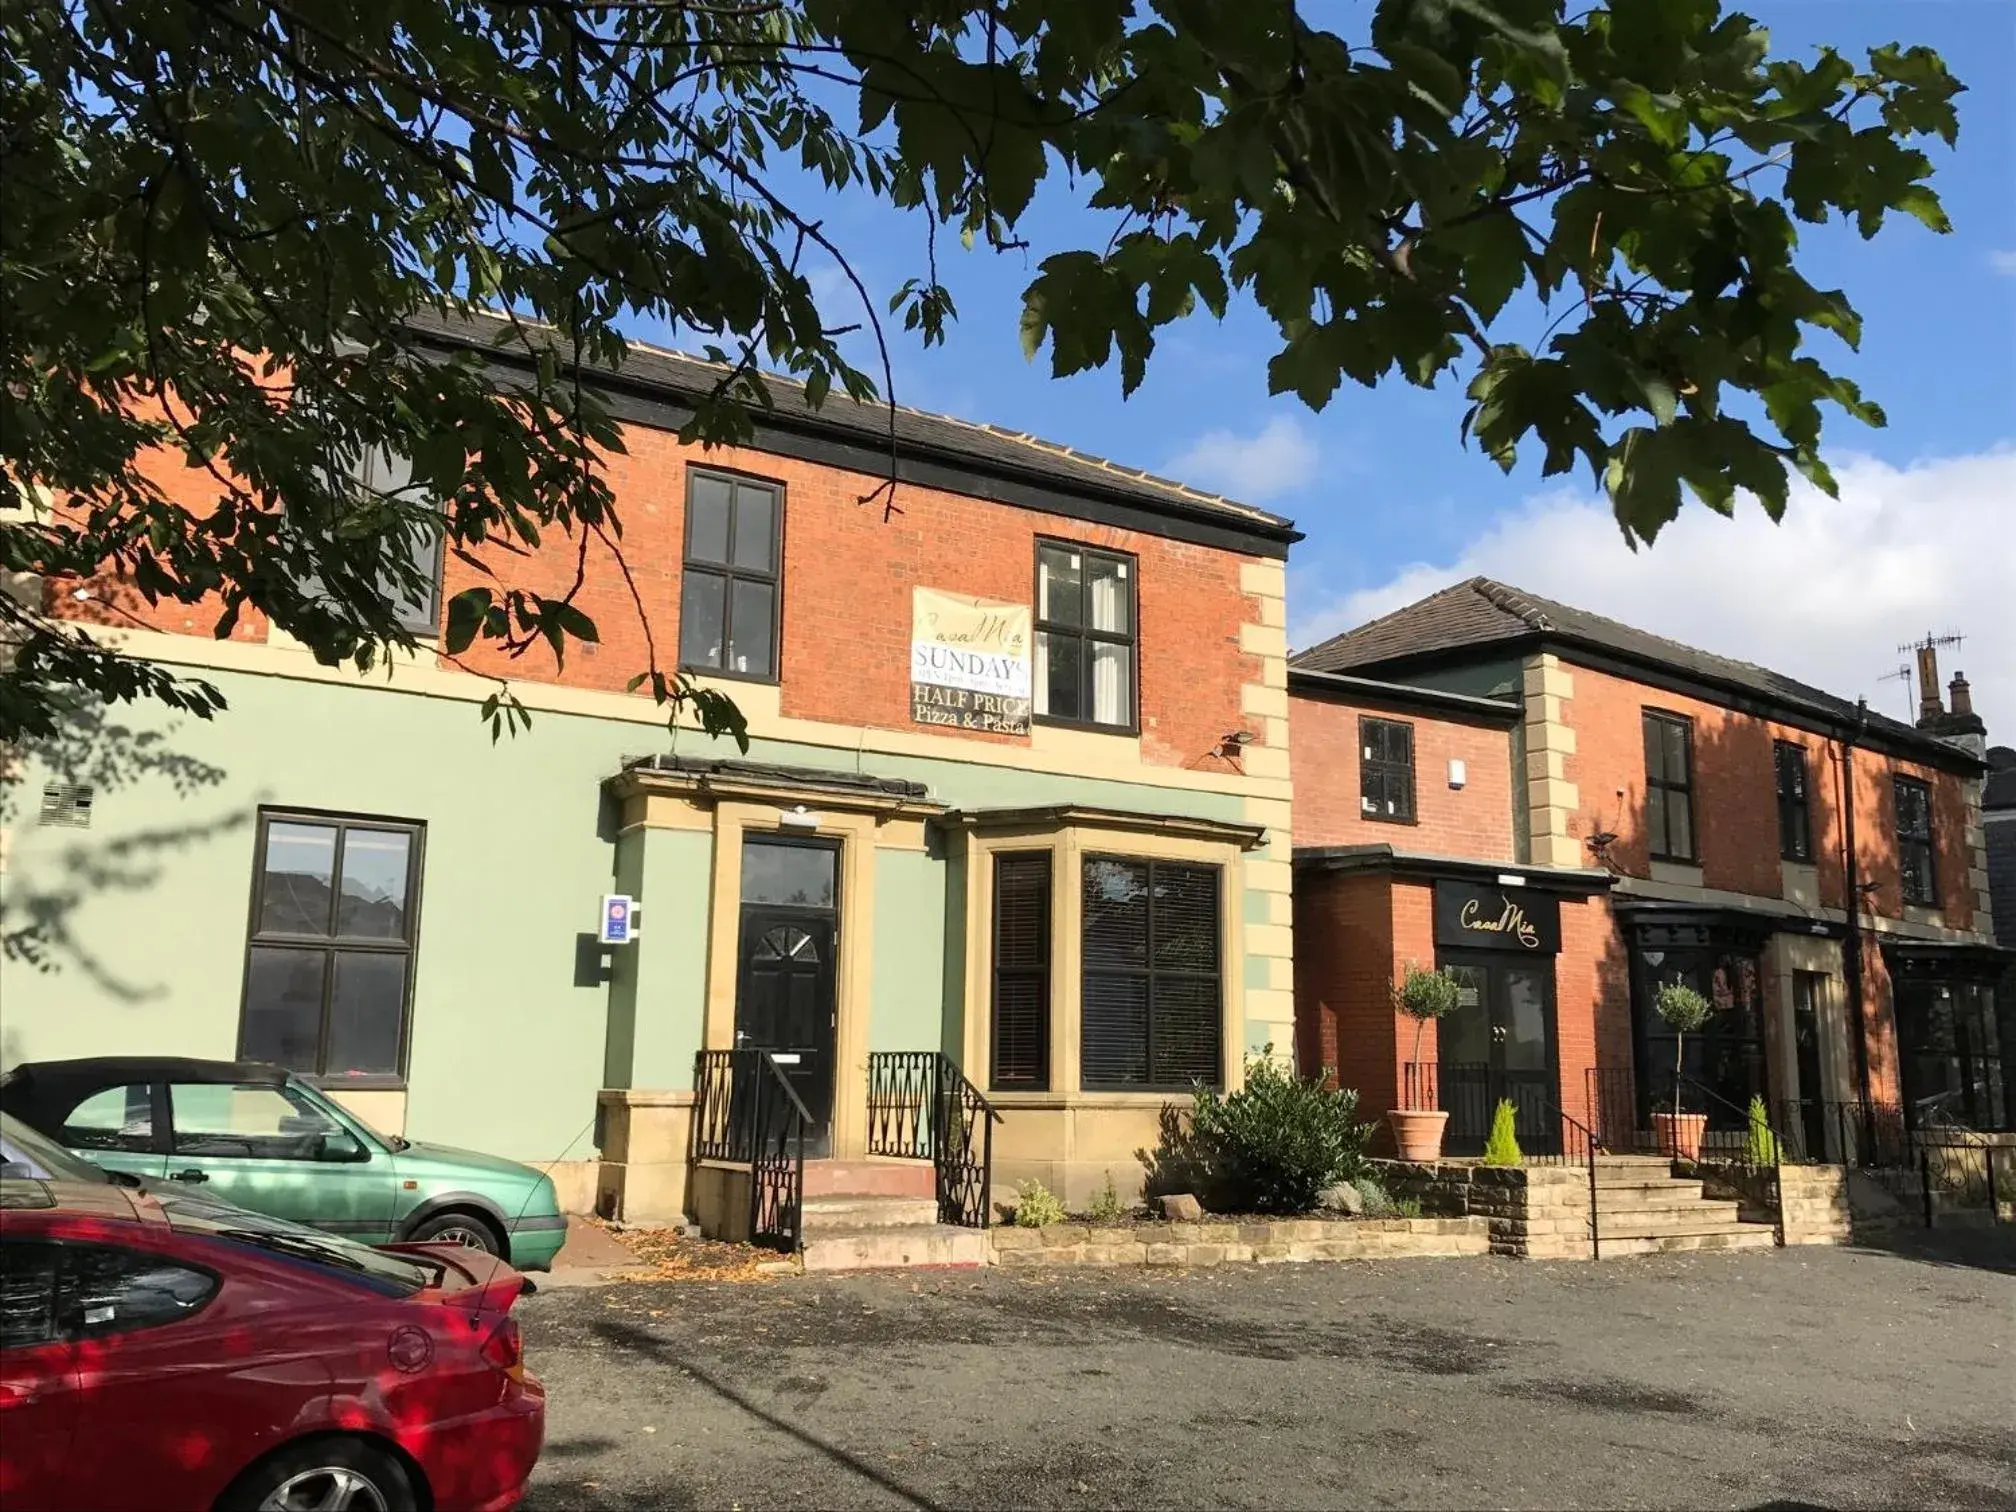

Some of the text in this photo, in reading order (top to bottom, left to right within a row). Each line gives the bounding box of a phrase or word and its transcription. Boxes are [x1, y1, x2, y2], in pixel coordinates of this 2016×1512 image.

[914, 685, 970, 709] HALF
[916, 704, 1024, 735] Pizza & Pasta
[1461, 894, 1539, 948] Casa Mia
